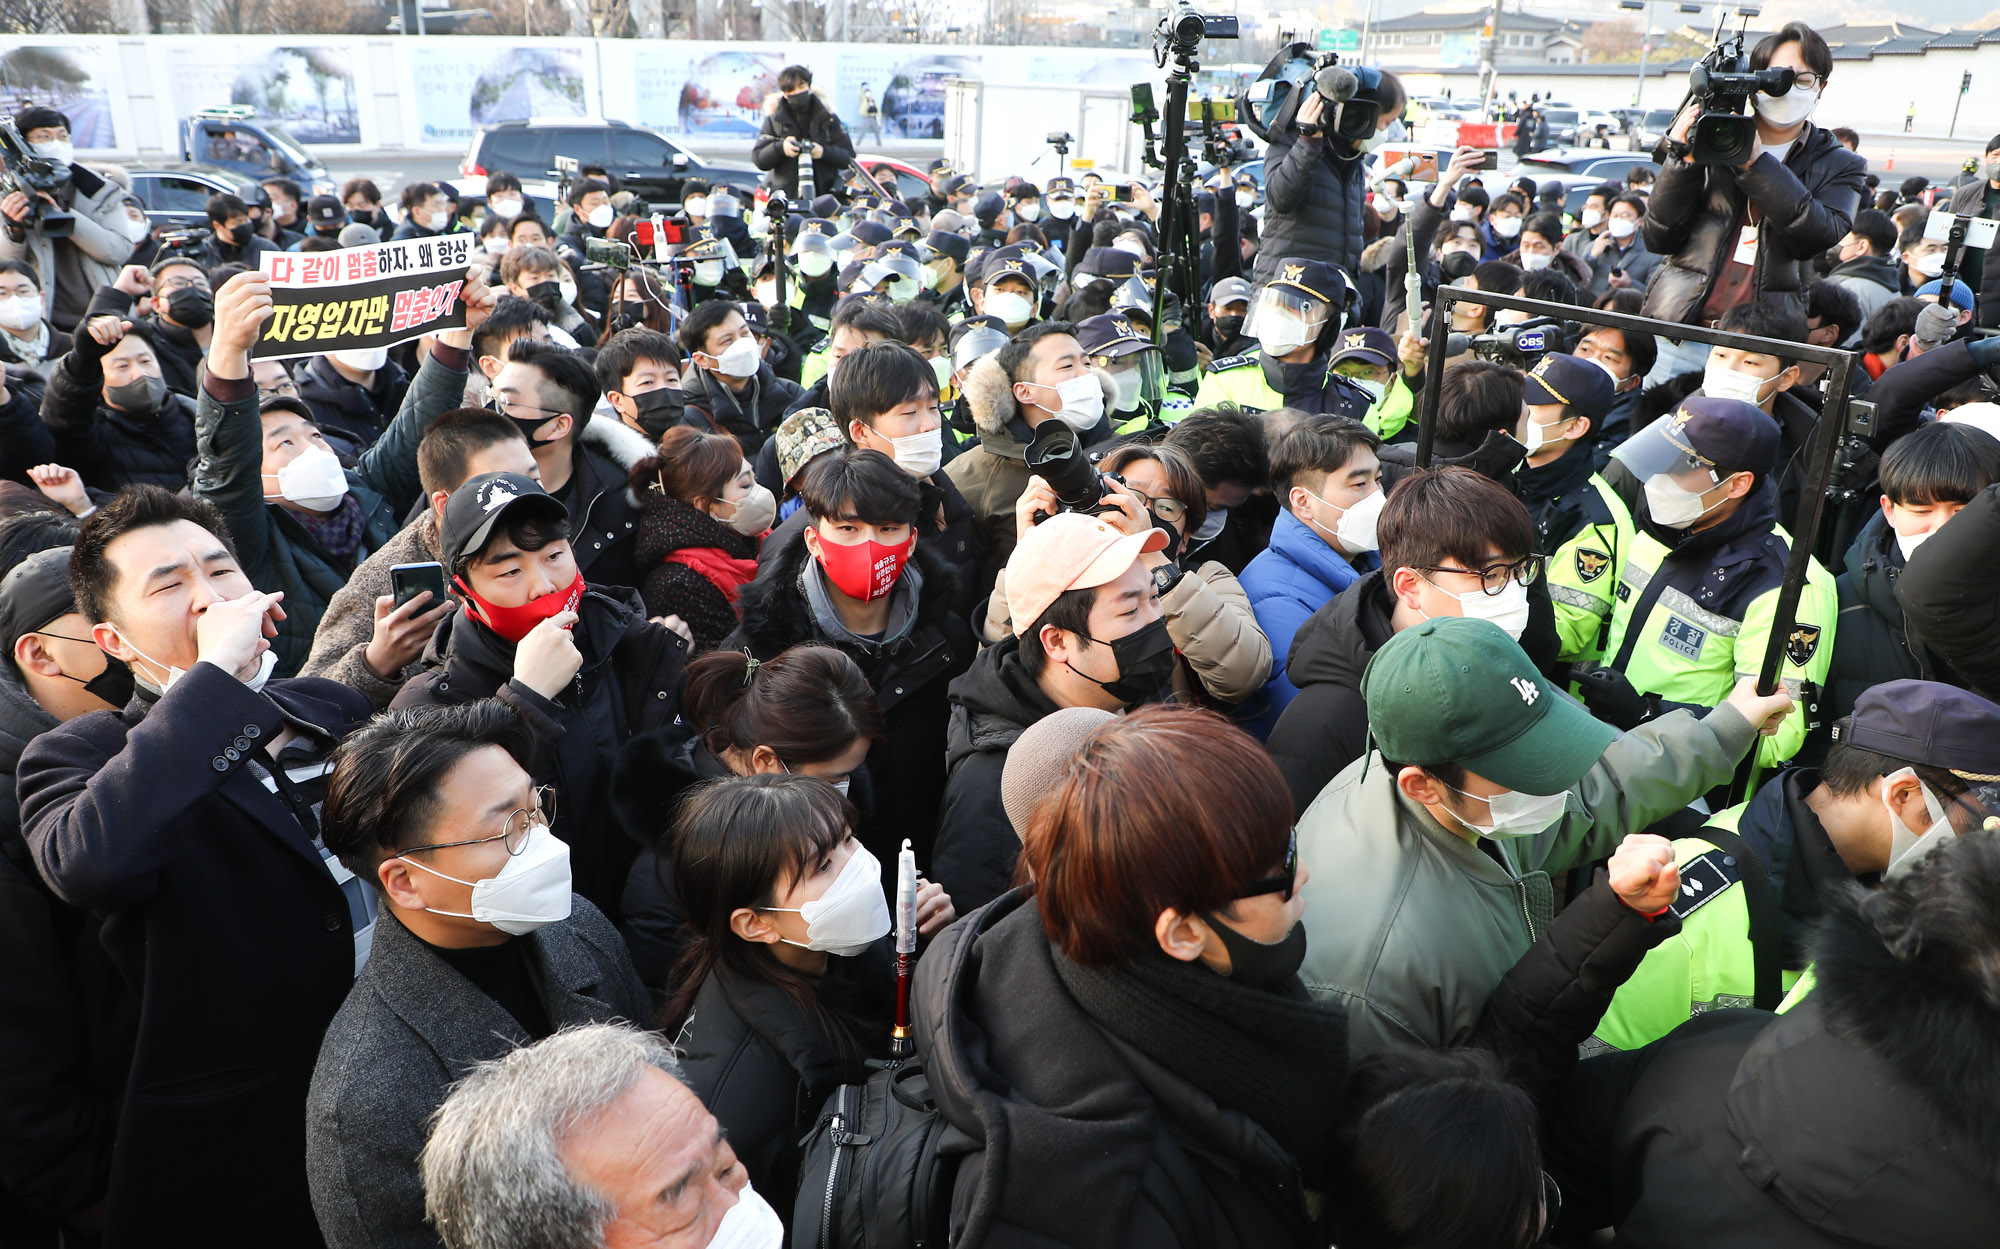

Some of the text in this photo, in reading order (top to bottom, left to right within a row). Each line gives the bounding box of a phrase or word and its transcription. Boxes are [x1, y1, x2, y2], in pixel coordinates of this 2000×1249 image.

[271, 240, 468, 284] 다 같이 멈춤하자. 왜 항상
[263, 280, 464, 342] 자영업자만 멈춤인가
[1519, 336, 1543, 347] OBS
[881, 574, 891, 586] 손실
[1663, 635, 1695, 656] POLICE
[1670, 618, 1701, 646] 경찰
[1510, 677, 1539, 705] LA
